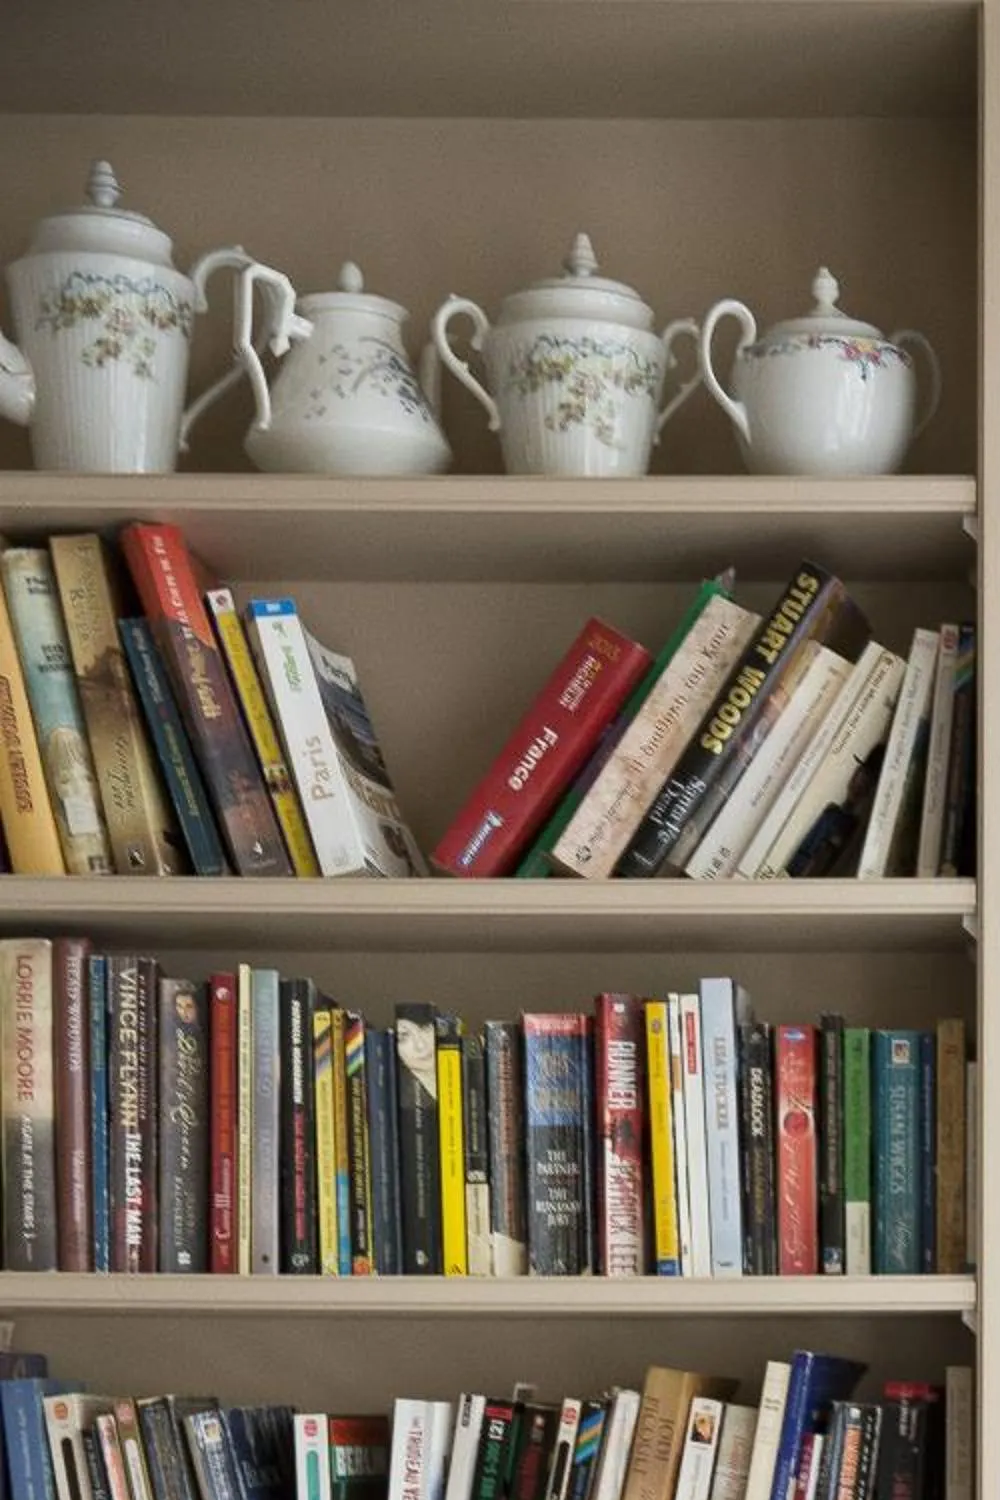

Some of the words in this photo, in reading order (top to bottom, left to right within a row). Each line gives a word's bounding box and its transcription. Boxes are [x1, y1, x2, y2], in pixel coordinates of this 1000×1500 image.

[755, 571, 820, 664] STUART
[699, 660, 767, 756] WOODS
[311, 735, 334, 802] Paris
[16, 955, 34, 1021] LORRIE
[119, 968, 138, 1042] VINCE
[17, 1027, 35, 1102] MOORE
[608, 1040, 638, 1110] RUNNER
[714, 1037, 730, 1067] LISA
[119, 1051, 138, 1127] FLYNN
[750, 1067, 763, 1137] DEADLOCK
[889, 1085, 907, 1135] SUSAN
[126, 1133, 142, 1162] THE
[126, 1167, 142, 1205] LAST
[126, 1209, 142, 1244] MAN
[609, 1240, 640, 1275] LEE
[657, 1414, 676, 1462] JODI
